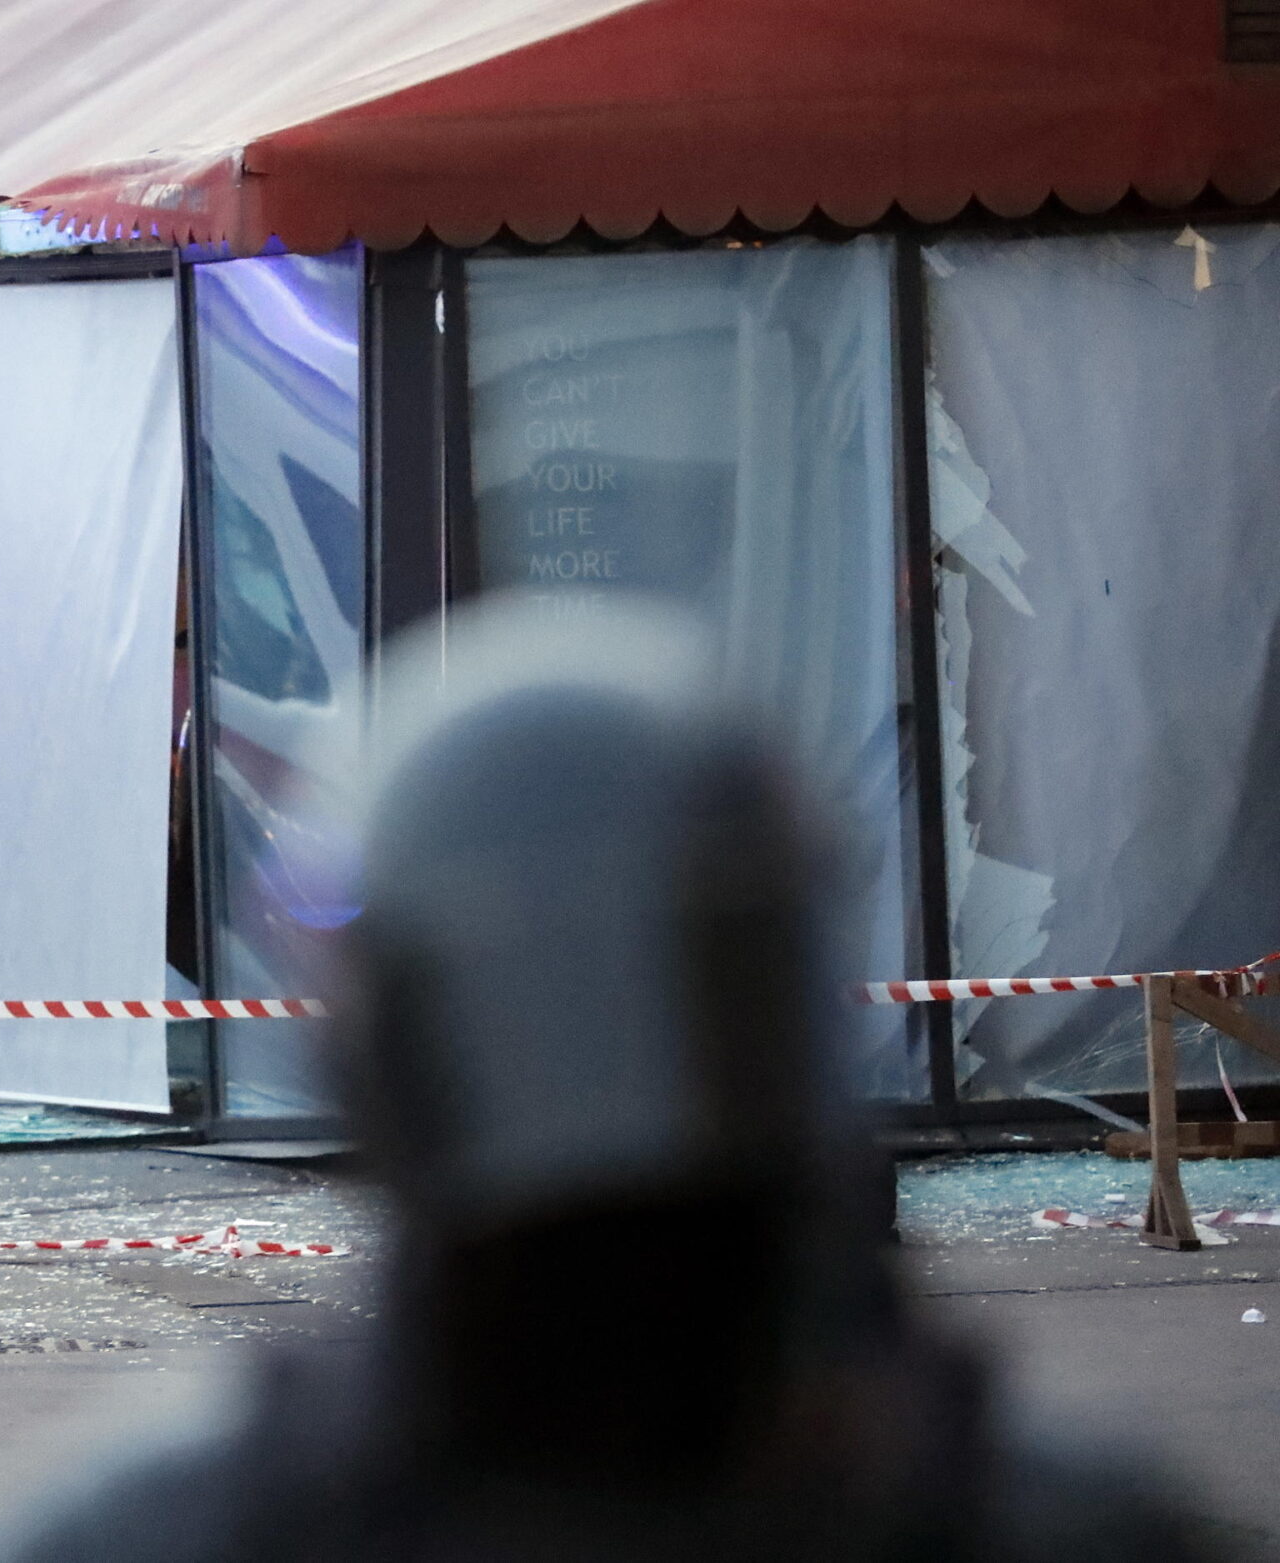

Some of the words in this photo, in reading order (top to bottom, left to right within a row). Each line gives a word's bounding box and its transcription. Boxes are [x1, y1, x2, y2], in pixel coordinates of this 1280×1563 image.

[522, 333, 590, 361] YOU
[522, 374, 624, 406] CAN'T
[525, 419, 601, 450] GIVE
[526, 462, 617, 493] YOUR
[528, 506, 595, 537] LIFE
[528, 549, 620, 580] MORE
